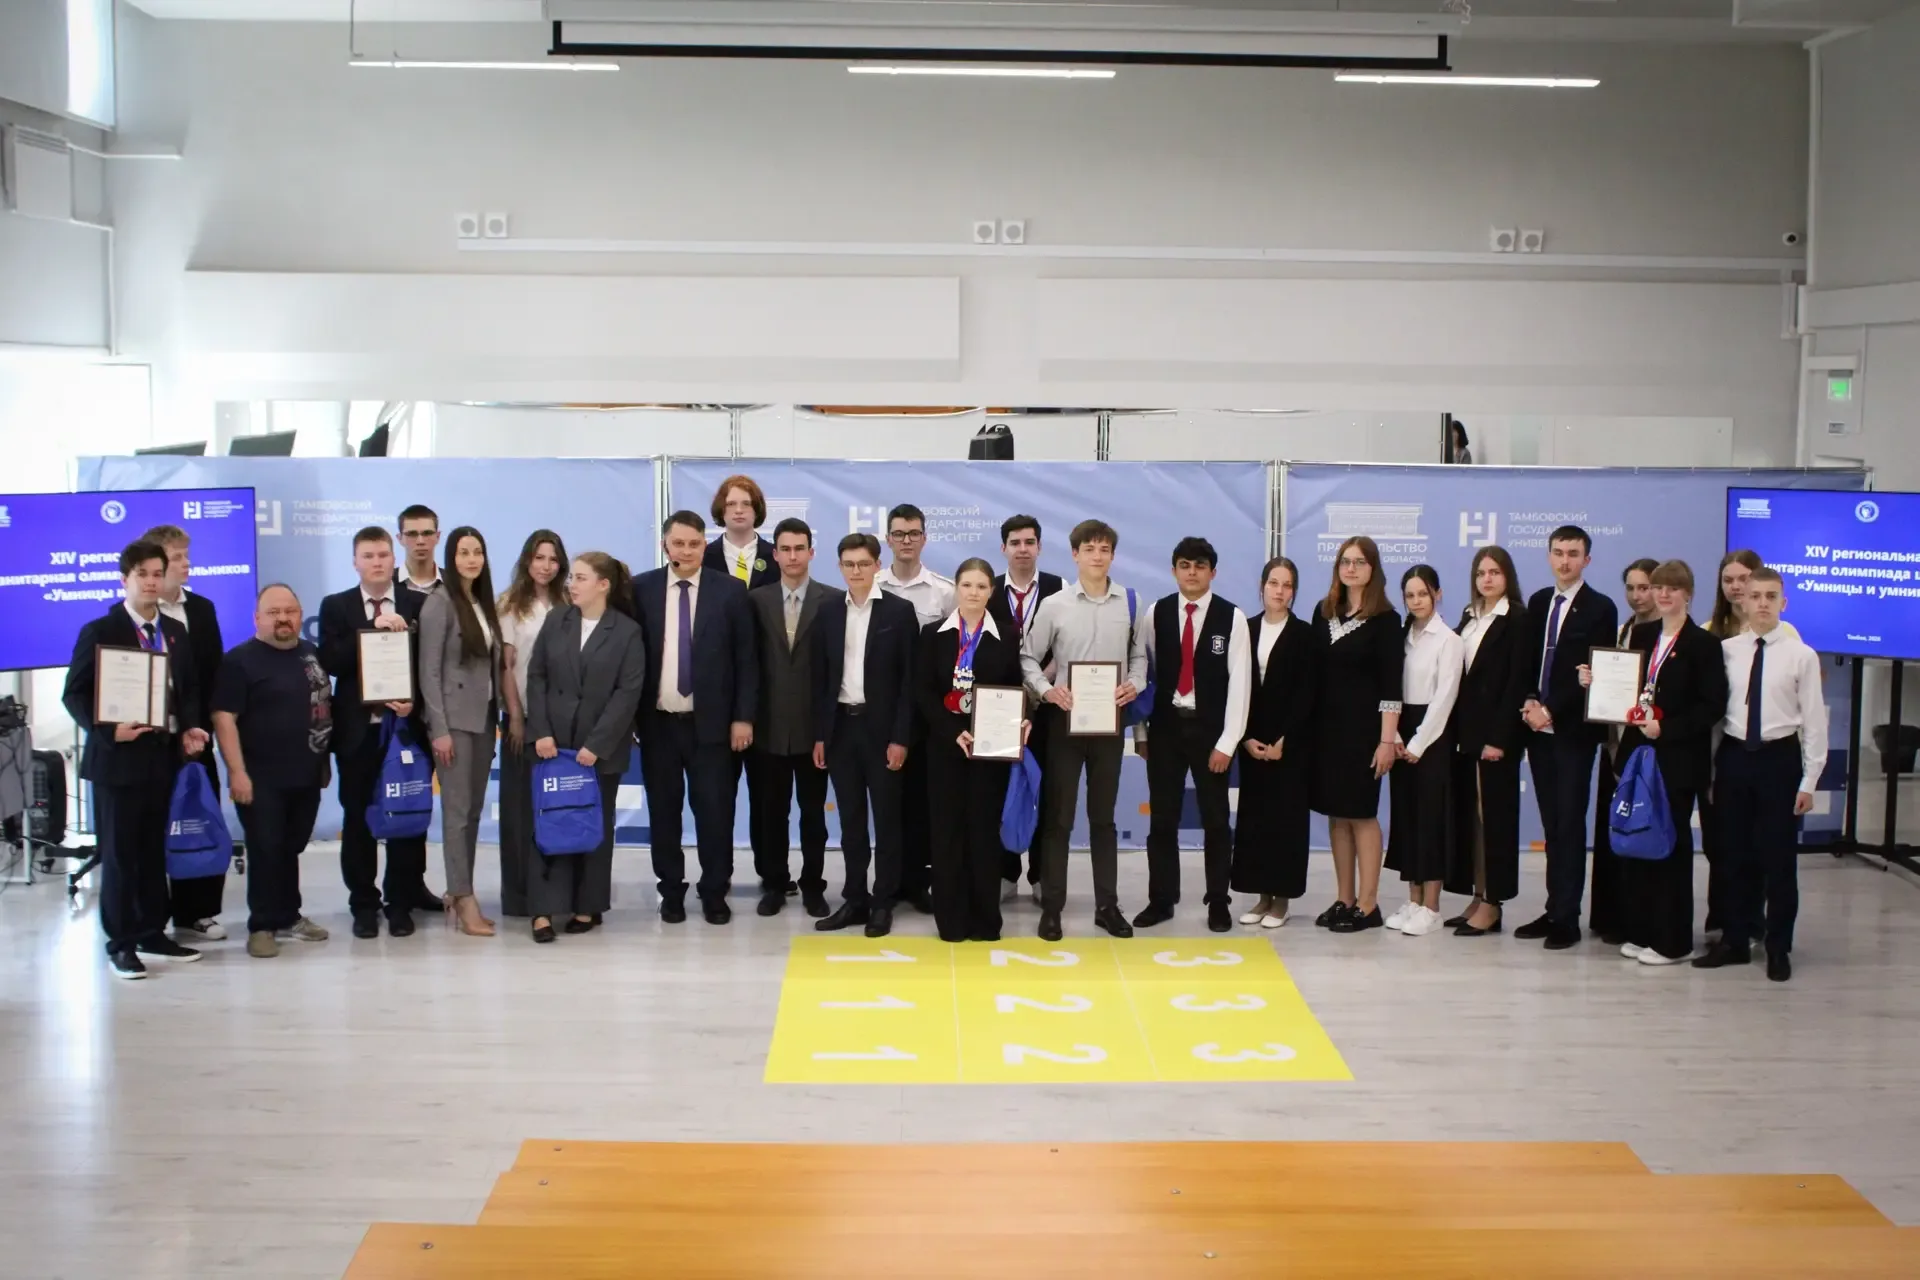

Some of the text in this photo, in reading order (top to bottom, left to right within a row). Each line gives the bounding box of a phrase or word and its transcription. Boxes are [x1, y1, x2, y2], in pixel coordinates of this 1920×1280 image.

[920, 505, 980, 516] БОВСКИЙ
[1508, 511, 1588, 522] ТАМБОВСКИЙ
[293, 513, 397, 524] ГОСУДАРСТВЕННЫ
[50, 551, 77, 565] XIV
[1805, 545, 1829, 558] XIV
[1383, 555, 1427, 564] ОБЛАСТИ
[1831, 567, 1911, 582] олимпиада
[1797, 579, 1863, 596] «Умницы
[1866, 585, 1876, 595] и
[43, 588, 114, 602] «Умницы
[826, 950, 917, 962] 1
[991, 950, 1079, 966] 2
[1154, 951, 1243, 967] 3
[819, 995, 916, 1008] 1
[995, 994, 1093, 1013] 2
[1170, 994, 1267, 1012] 3
[812, 1045, 917, 1060] 1
[1002, 1043, 1108, 1065] 2
[1192, 1043, 1297, 1063] 3
